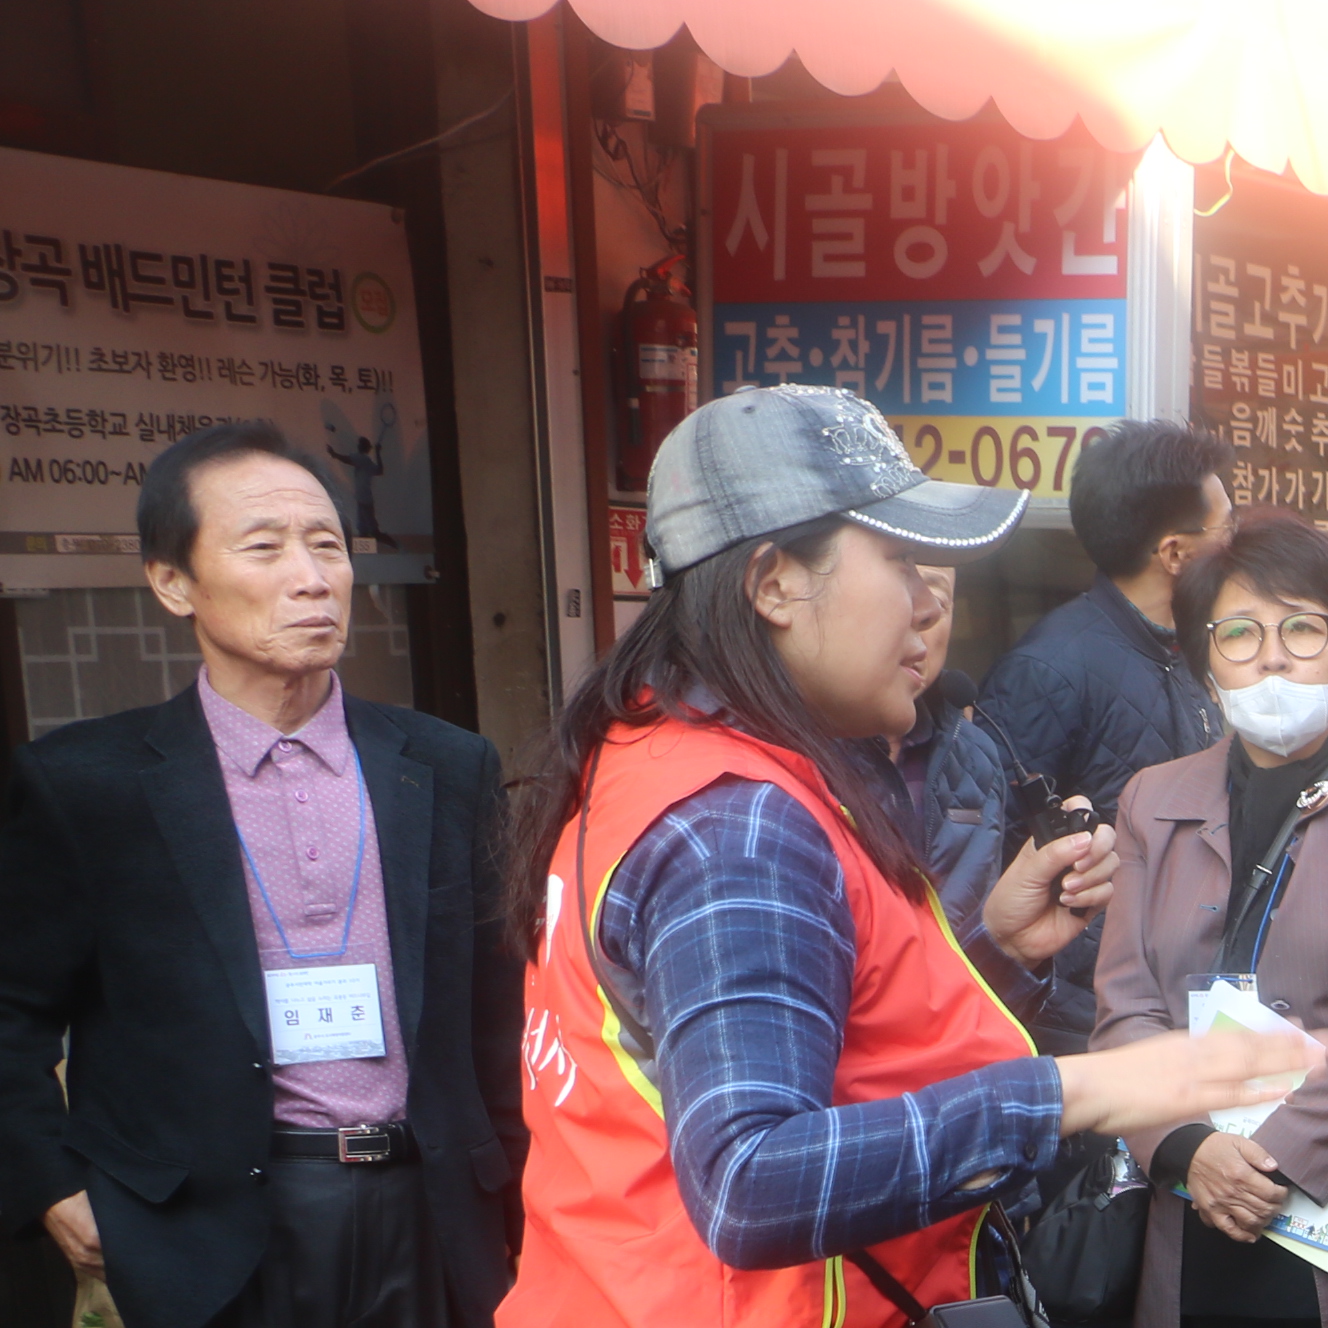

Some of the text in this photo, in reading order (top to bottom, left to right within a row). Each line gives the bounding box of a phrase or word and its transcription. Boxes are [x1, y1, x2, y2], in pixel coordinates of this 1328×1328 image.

[725, 143, 1126, 281] 시골방앗간
[78, 243, 257, 325] 배드민턴
[264, 261, 346, 332] 클럽
[88, 346, 153, 380] 초보자
[158, 350, 212, 383] 환영!!
[218, 357, 255, 387] 레슨
[1, 404, 128, 440] 장곡초등학교
[9, 457, 44, 482] AM
[609, 513, 647, 531] 소화
